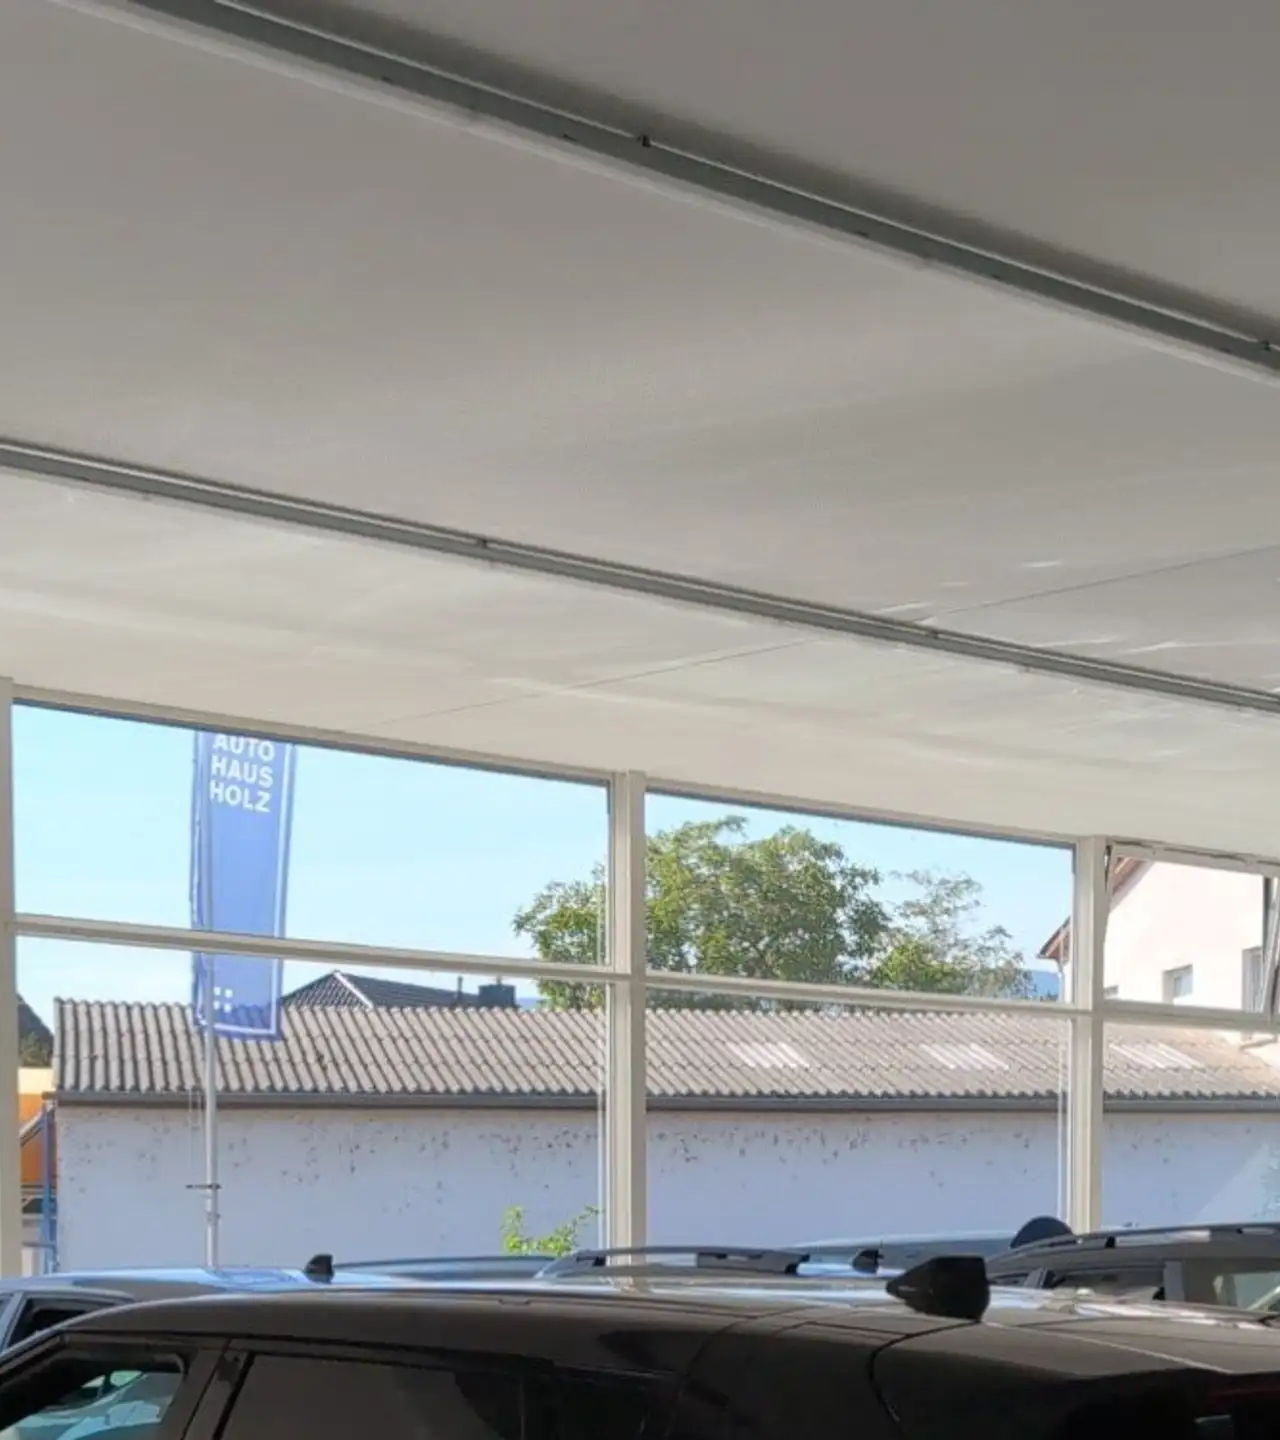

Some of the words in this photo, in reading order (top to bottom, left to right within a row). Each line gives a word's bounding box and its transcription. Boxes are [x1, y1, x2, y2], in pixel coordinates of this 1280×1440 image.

[213, 734, 274, 761] AUTO
[211, 753, 274, 788] HAUS
[209, 780, 271, 813] HOLZ
